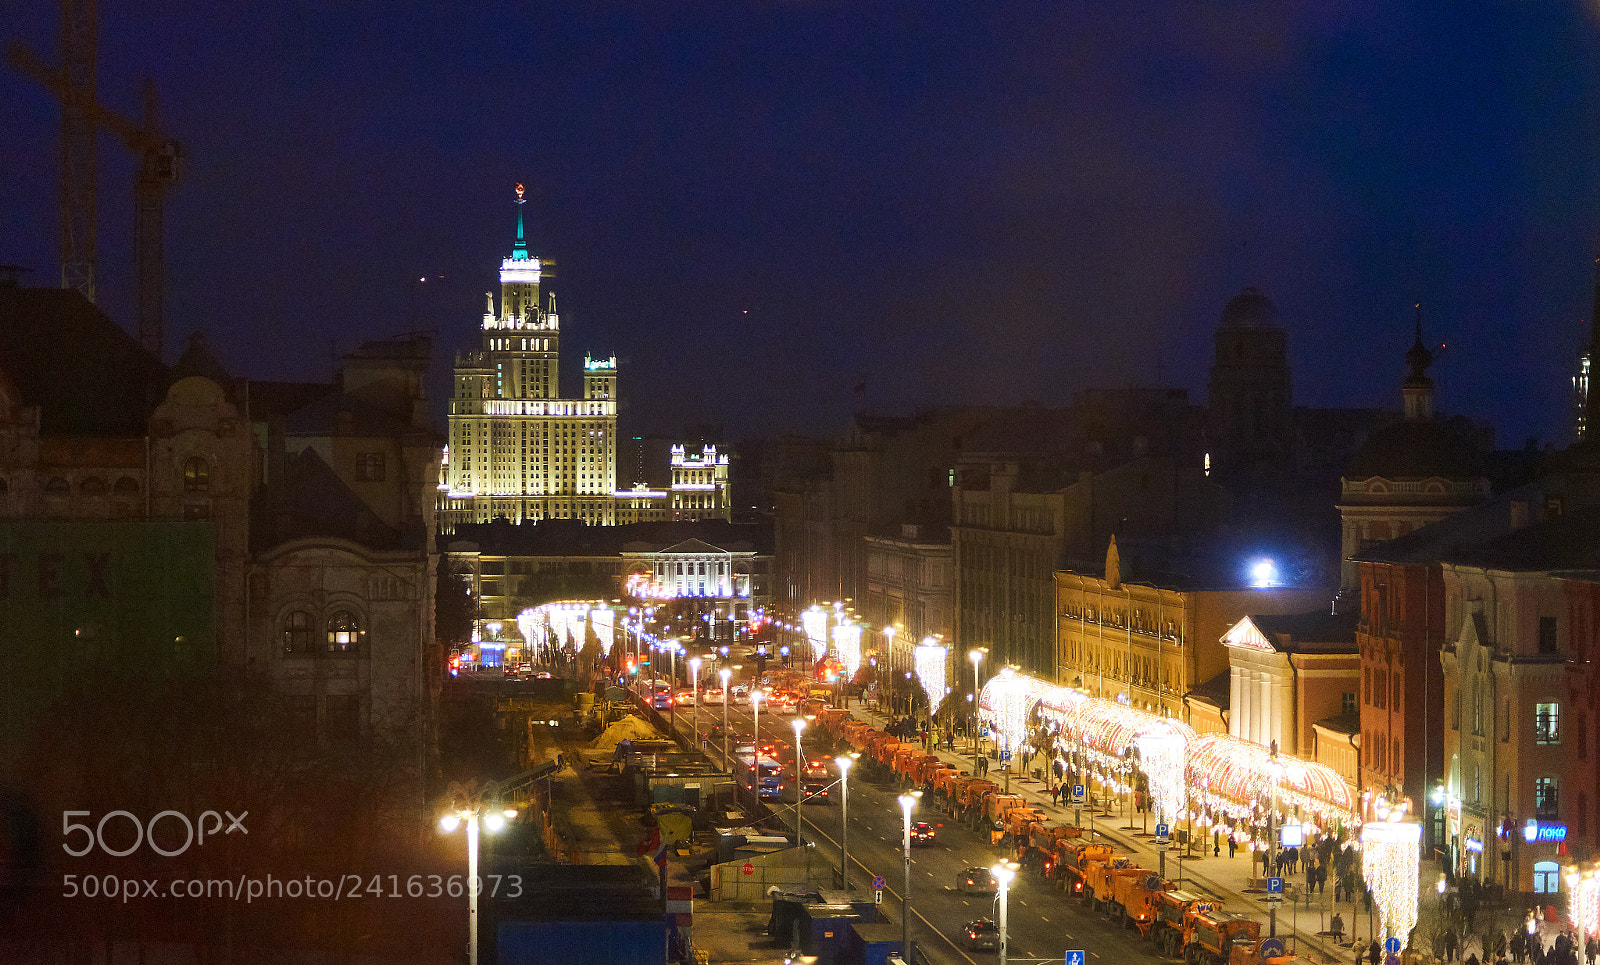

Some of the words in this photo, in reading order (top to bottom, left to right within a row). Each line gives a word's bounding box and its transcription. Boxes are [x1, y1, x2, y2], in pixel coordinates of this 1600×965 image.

[981, 727, 988, 736] P
[1003, 751, 1009, 759] P
[1076, 785, 1082, 795] P
[1160, 825, 1166, 835] P
[1271, 879, 1279, 890] P
